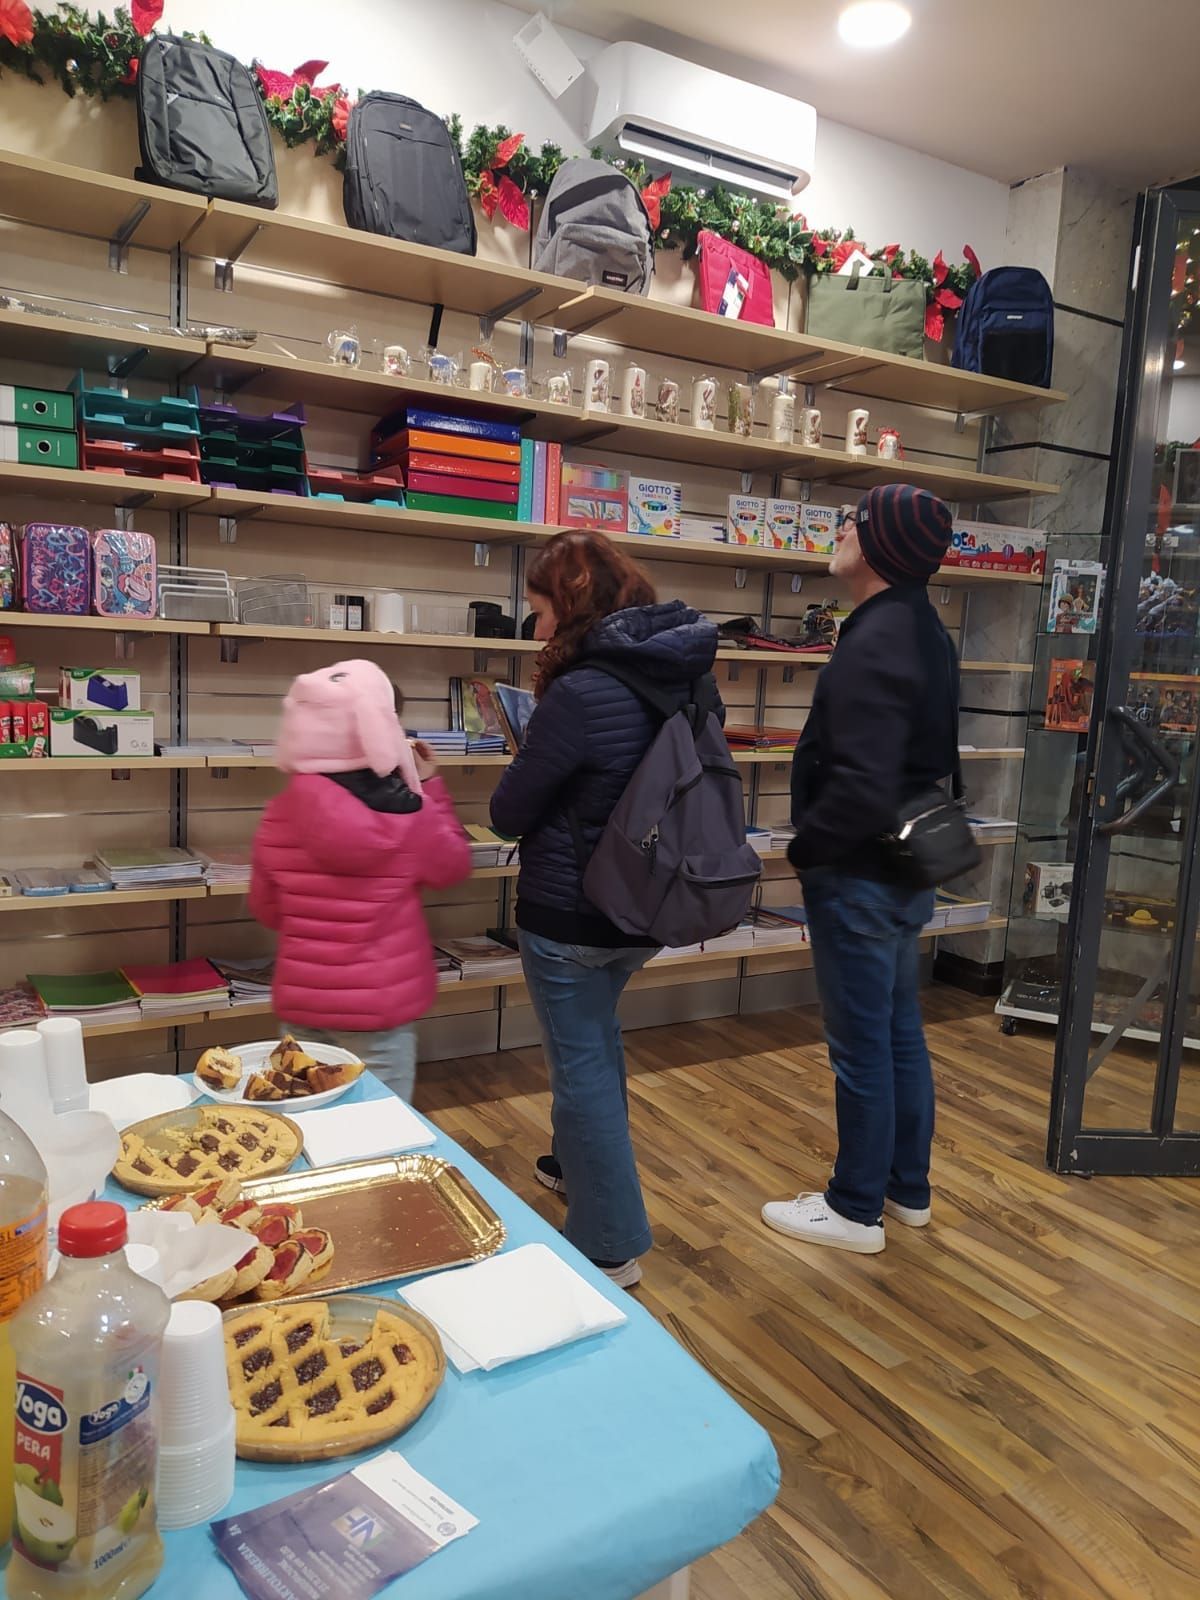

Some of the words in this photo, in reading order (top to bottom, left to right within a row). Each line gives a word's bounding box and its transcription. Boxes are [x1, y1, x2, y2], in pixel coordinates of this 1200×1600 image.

[638, 483, 672, 496] GIOTTO
[736, 499, 760, 508] GIOTTO
[773, 503, 796, 512] GIOTTO
[805, 508, 832, 519] GIOTTO
[17, 1431, 51, 1461] PERA
